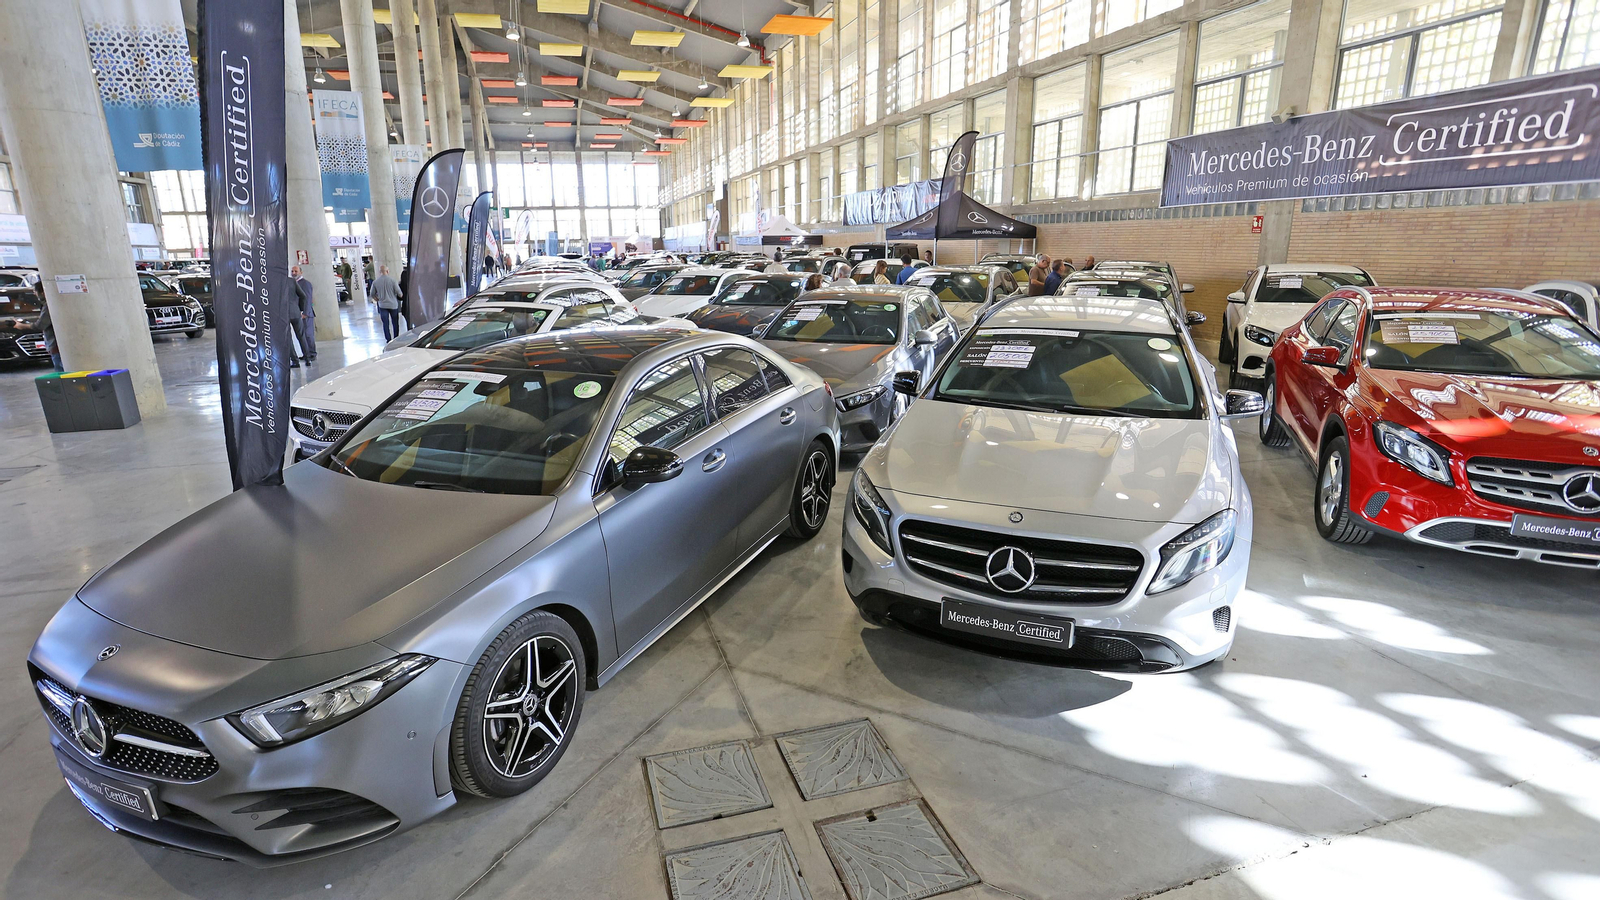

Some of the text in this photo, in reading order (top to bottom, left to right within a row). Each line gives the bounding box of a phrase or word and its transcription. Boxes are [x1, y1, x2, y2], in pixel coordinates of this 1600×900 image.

[318, 99, 358, 110] IFECA
[152, 132, 185, 140] Diputación
[1187, 98, 1575, 177] Mercedes-Benz Certified
[1185, 168, 1369, 196] Vehículos Premium de ocasión
[226, 64, 264, 430] Mercedes-Benz Certified
[257, 227, 276, 434] Vehículos Premium de ocasión
[1521, 522, 1592, 538] Mercedes-Benz
[948, 610, 1061, 639] Mercedes-Benz Certified
[104, 786, 141, 809] Certified
